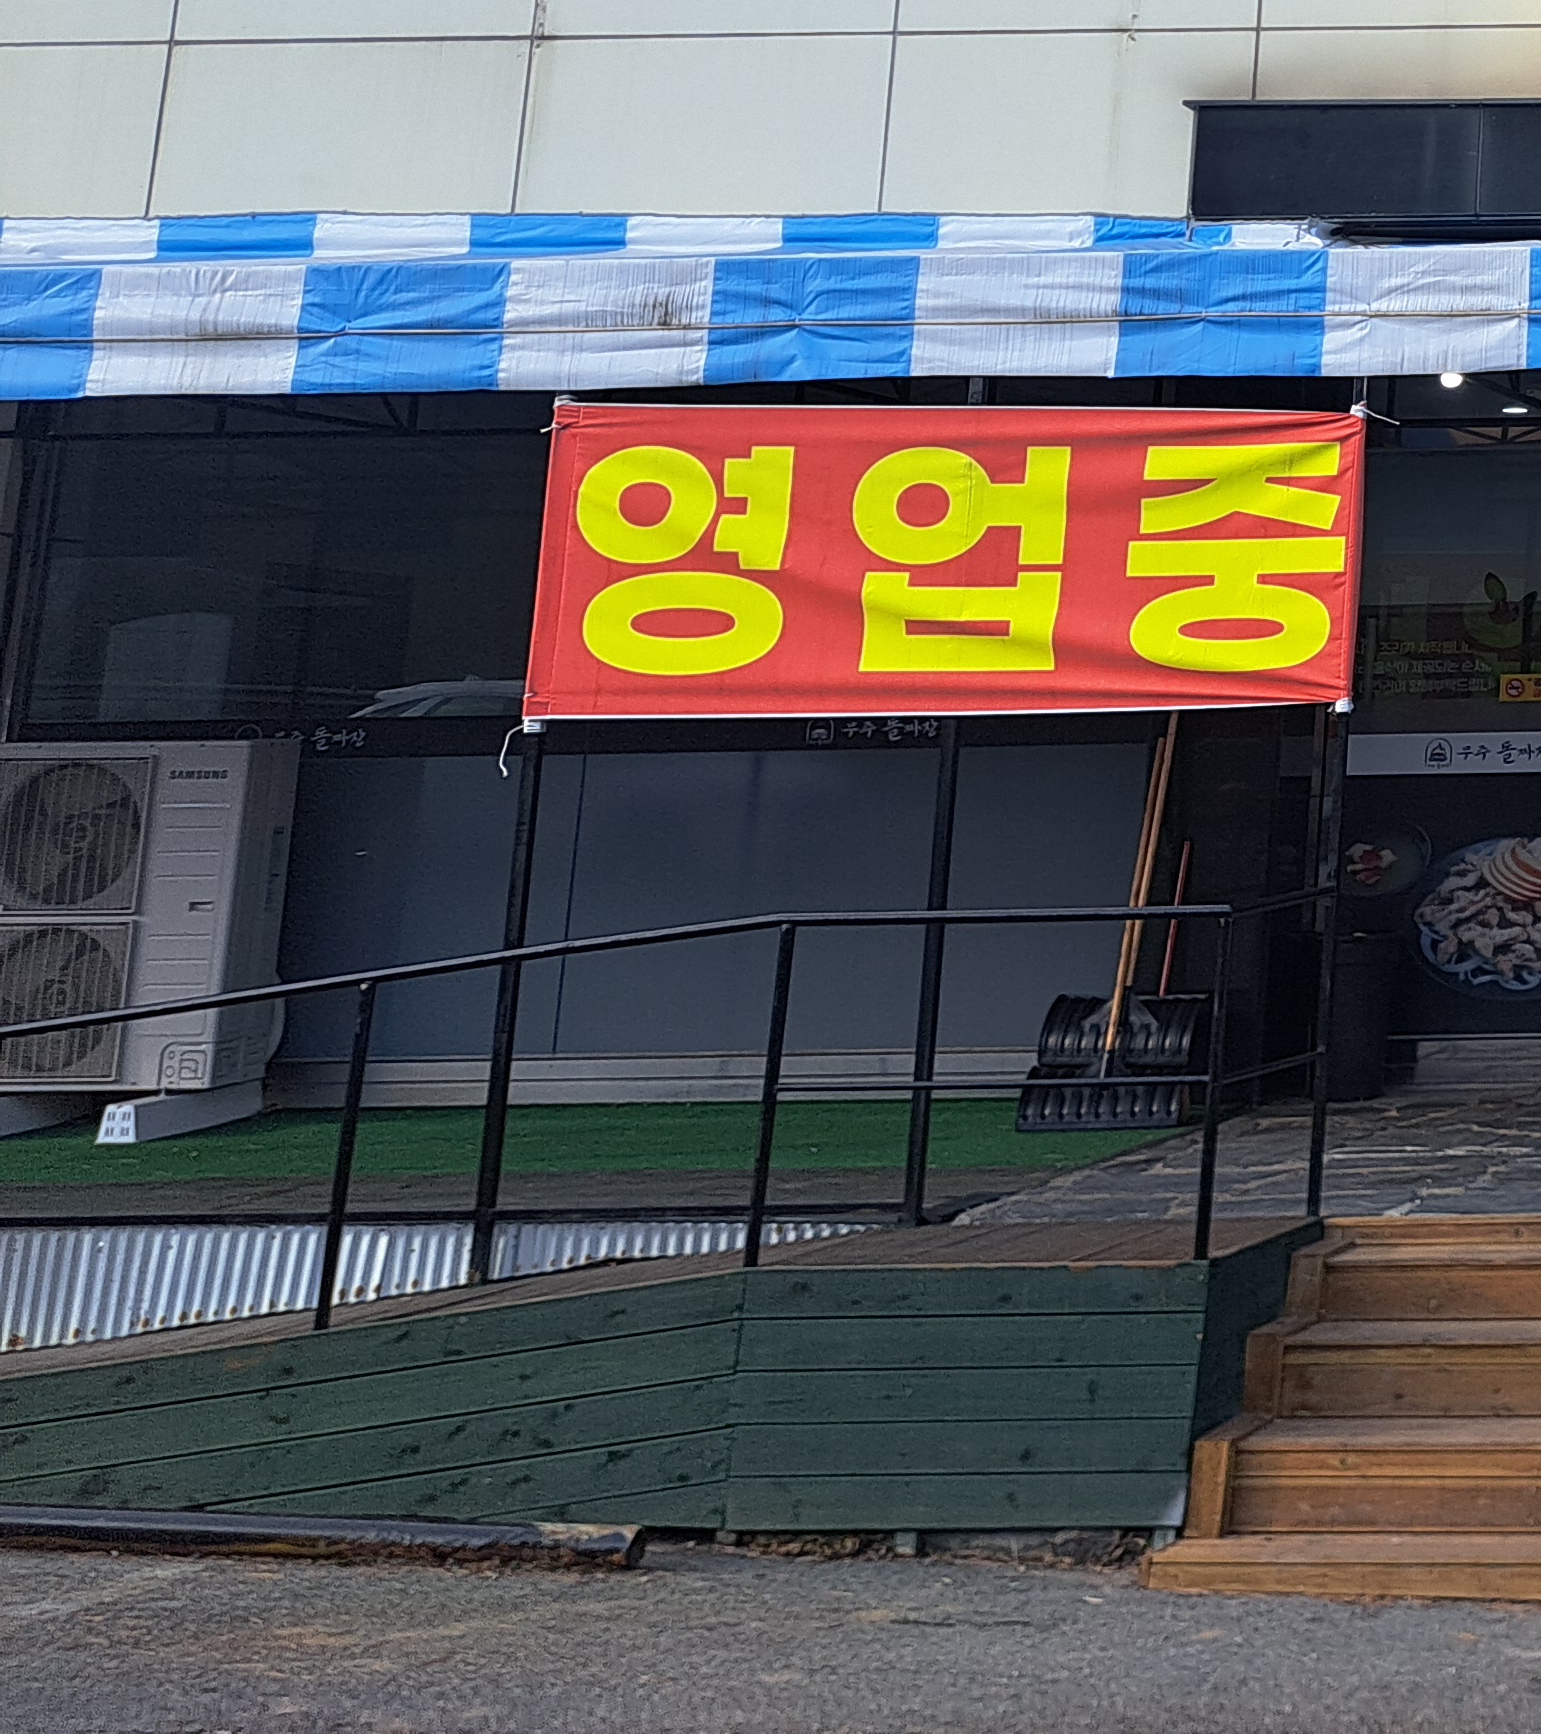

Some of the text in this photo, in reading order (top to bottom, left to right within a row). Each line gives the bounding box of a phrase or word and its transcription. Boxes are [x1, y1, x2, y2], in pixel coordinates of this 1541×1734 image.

[576, 442, 1346, 676] 영업중
[1457, 744, 1492, 761] 무주
[168, 769, 229, 780] SAMSUNG
